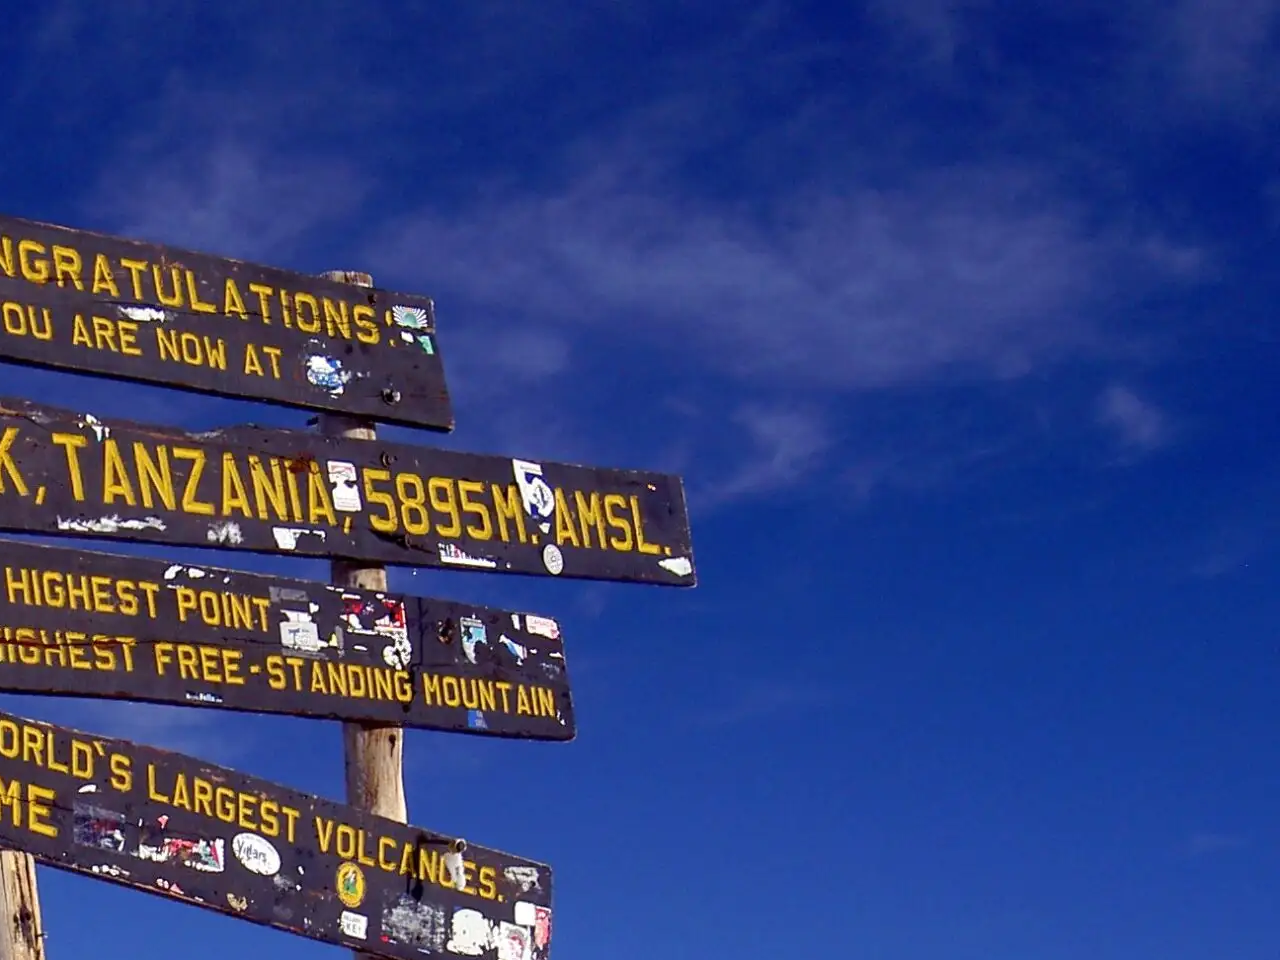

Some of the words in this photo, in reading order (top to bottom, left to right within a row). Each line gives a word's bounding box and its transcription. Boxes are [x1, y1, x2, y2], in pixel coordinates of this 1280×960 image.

[73, 315, 142, 355] ARE
[156, 328, 226, 369] NOW
[245, 344, 282, 379] AT
[52, 433, 349, 533] TANZANIA,
[555, 488, 671, 554] AMSL.
[6, 567, 159, 618] HIGHEST
[176, 588, 270, 630] POINT
[155, 643, 412, 701] FREE-STANDING
[423, 674, 555, 716] MOUNTAIN
[148, 764, 300, 842] LARGEST
